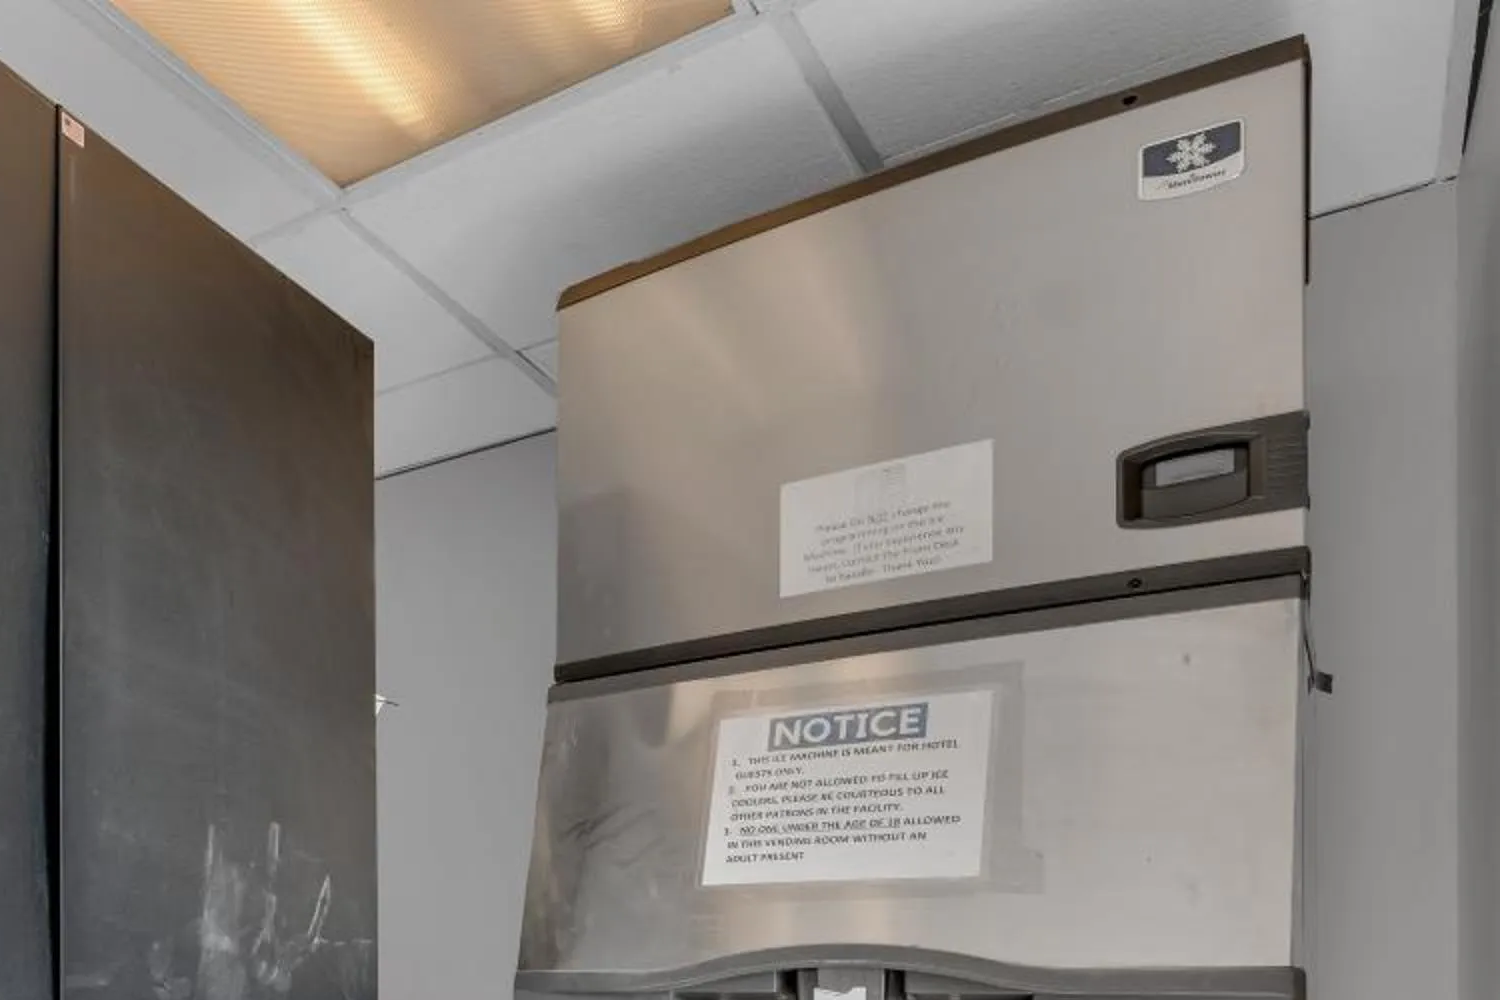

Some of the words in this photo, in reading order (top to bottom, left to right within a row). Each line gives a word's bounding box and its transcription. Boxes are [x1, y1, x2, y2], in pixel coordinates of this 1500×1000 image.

[773, 706, 922, 747] NOTICE
[748, 755, 770, 765] THIS
[789, 749, 838, 761] MACHINE
[841, 747, 850, 757] IS
[853, 744, 893, 755] MEANT
[897, 741, 918, 752] FOR
[921, 739, 958, 751] HOTEL
[735, 769, 772, 780] GUESTS
[745, 783, 766, 793] YOU
[768, 781, 788, 791] ARE
[791, 779, 812, 790] NOT
[815, 775, 868, 787] ALLOWED
[870, 772, 886, 783] TO
[888, 771, 908, 782] FILL
[911, 770, 928, 780] UP
[781, 793, 817, 804] PLEASE
[820, 792, 833, 801] BE
[835, 787, 903, 801] COURTEOUS
[906, 786, 922, 796] TO
[925, 785, 944, 796] ALL
[729, 812, 762, 822] OTHER
[765, 807, 813, 819] PATRONS
[815, 807, 827, 815] IN
[830, 804, 850, 815] THE
[739, 825, 755, 835] NO
[757, 824, 778, 835] ONE
[781, 822, 818, 832] UNDER
[821, 820, 840, 830] THE
[843, 818, 866, 830] AGE
[869, 818, 882, 828] OF
[902, 813, 961, 827] ALLOWED
[727, 840, 738, 849] IN
[741, 838, 761, 848] THIS
[764, 835, 810, 848] VENDING
[814, 834, 849, 845] ROOM
[852, 830, 905, 844] WITHOUT
[909, 828, 927, 841] AN
[725, 853, 757, 863] ADULT
[760, 849, 804, 862] PRESENT
